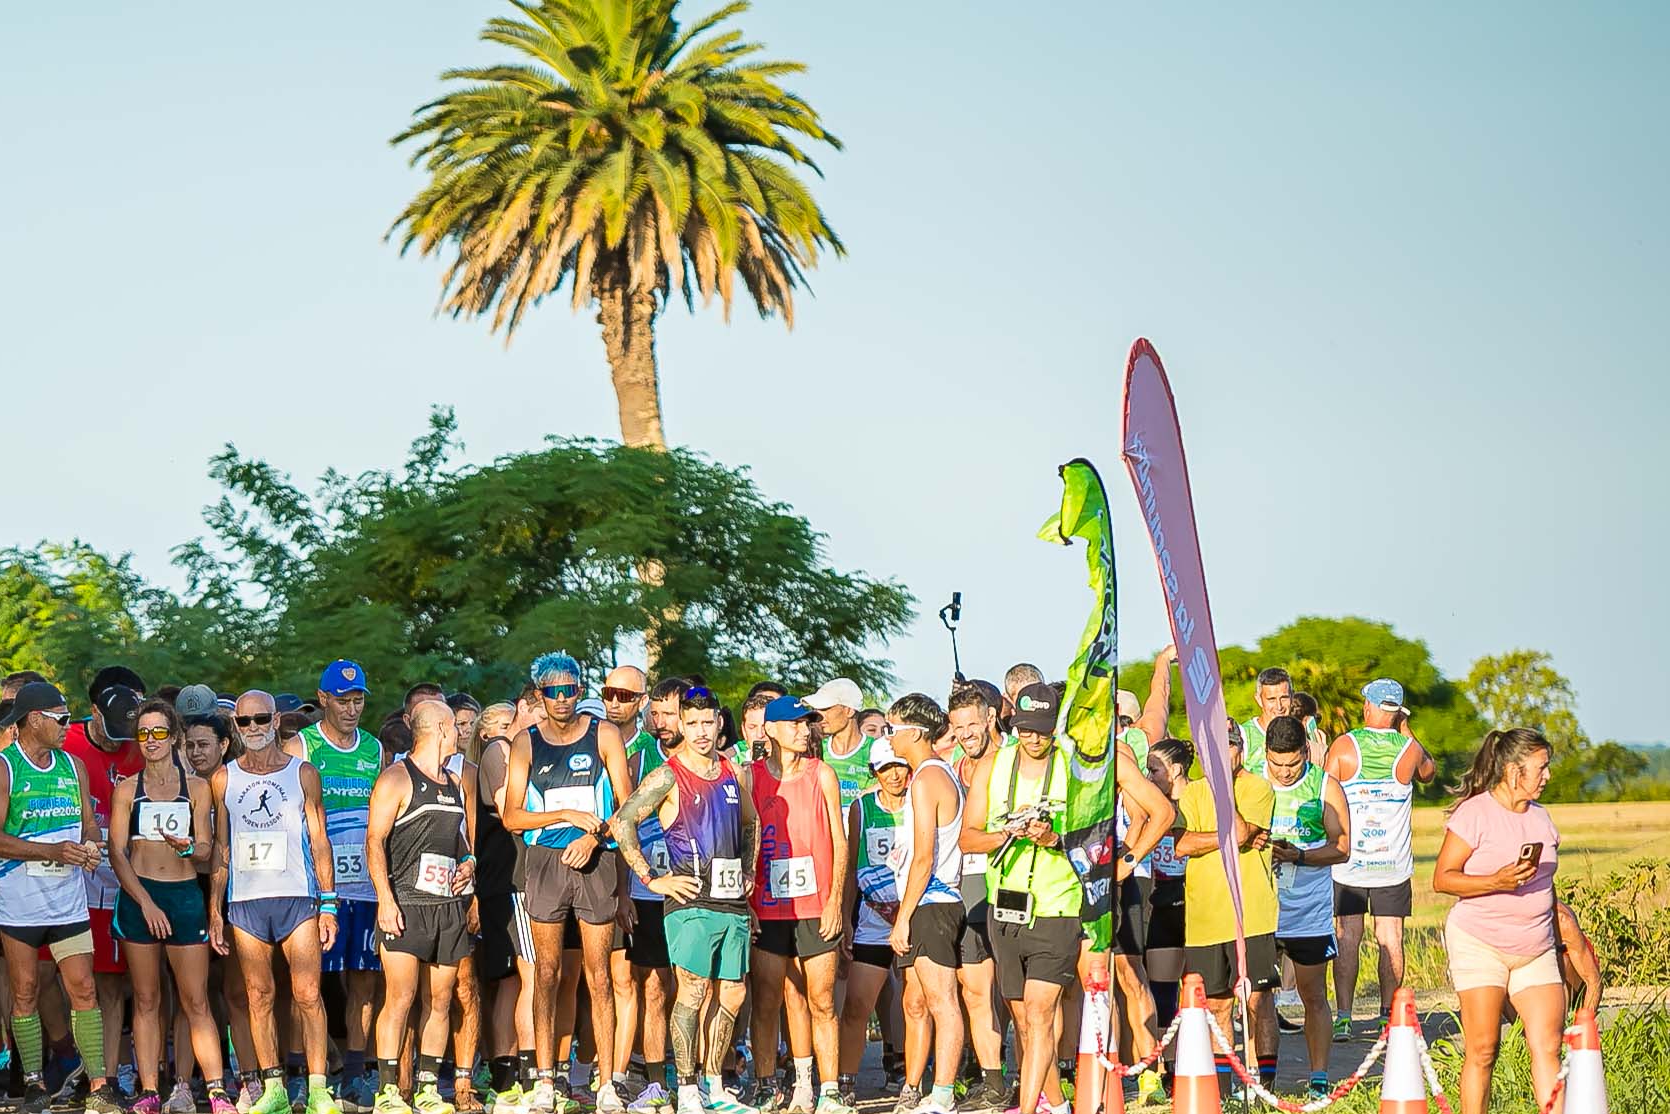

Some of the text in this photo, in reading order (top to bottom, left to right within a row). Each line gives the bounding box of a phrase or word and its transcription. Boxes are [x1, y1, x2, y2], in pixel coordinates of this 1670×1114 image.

[152, 813, 180, 832] 16
[247, 842, 274, 862] 17
[656, 851, 668, 870] 1
[336, 855, 363, 875] 53
[424, 864, 455, 886] 53
[778, 868, 807, 888] 45
